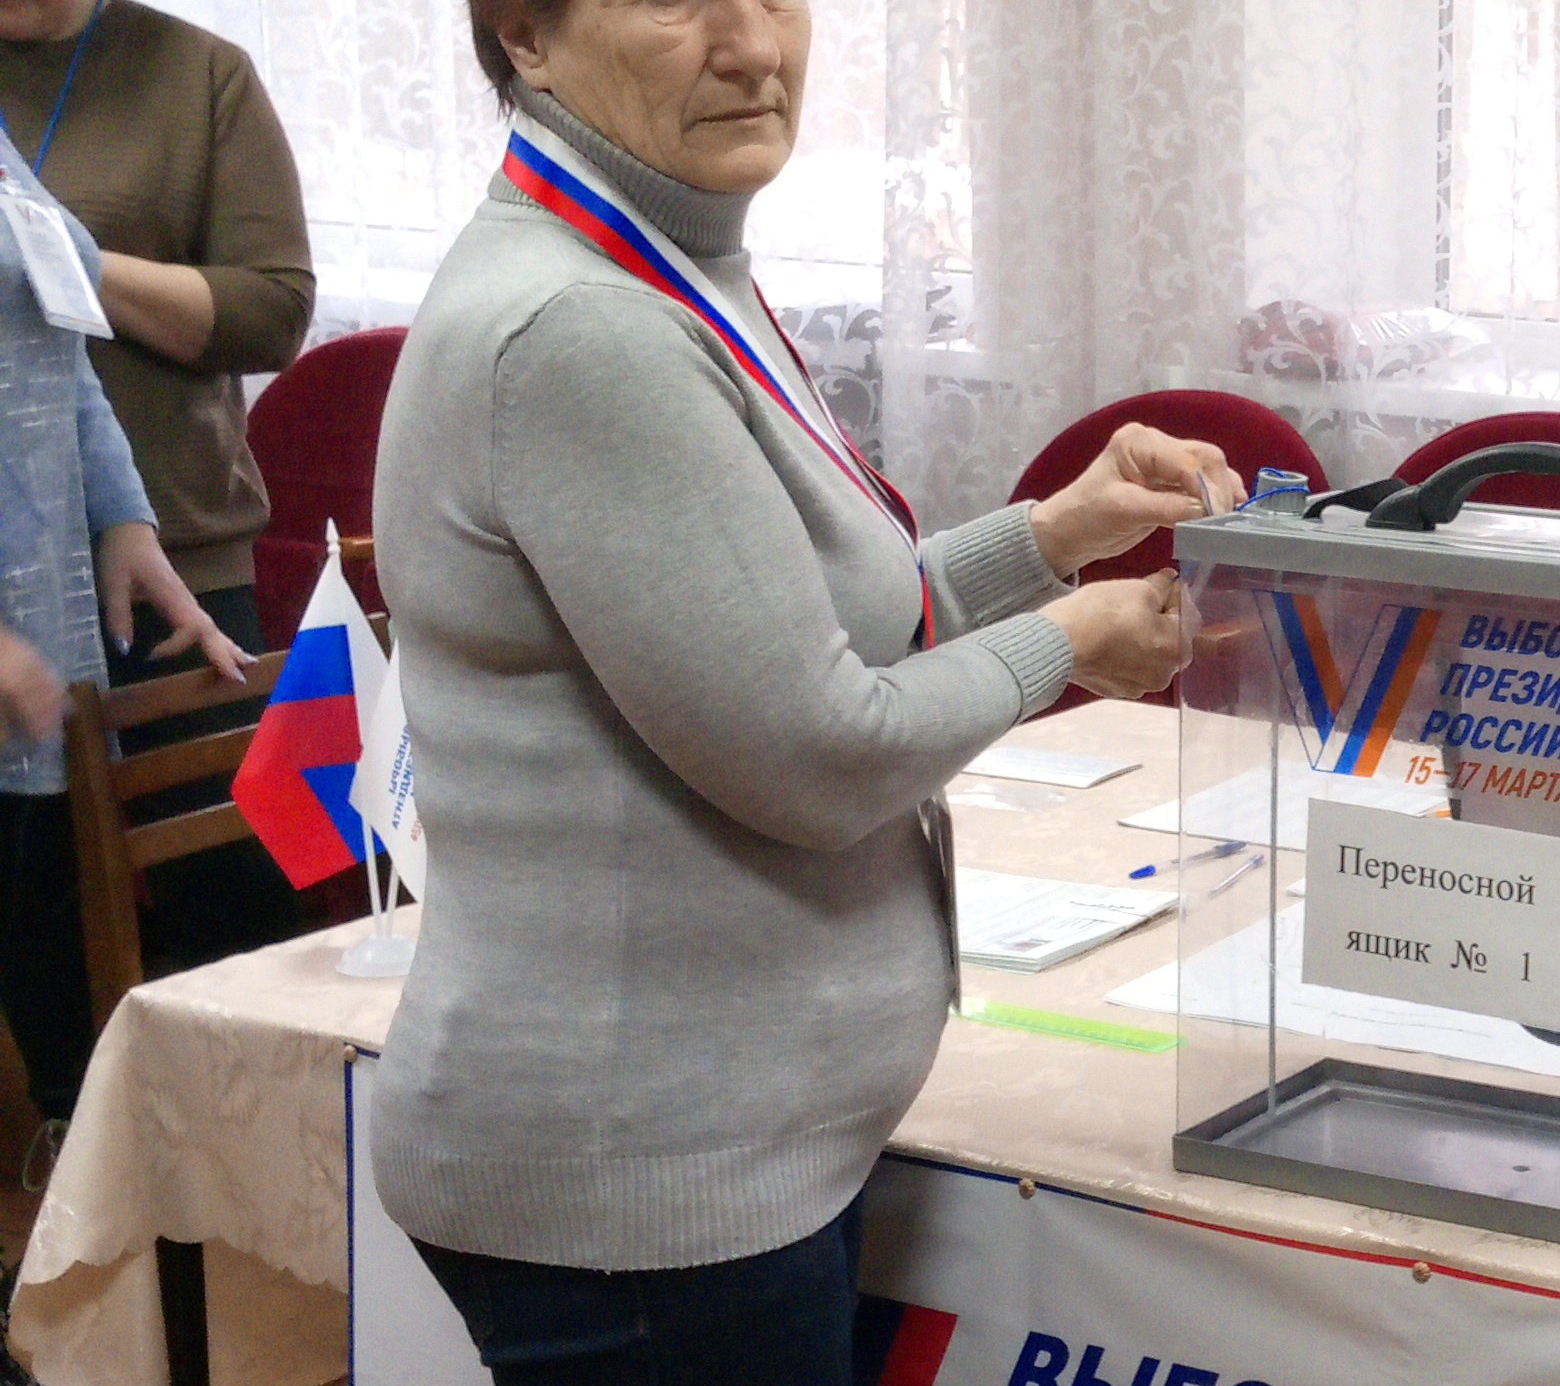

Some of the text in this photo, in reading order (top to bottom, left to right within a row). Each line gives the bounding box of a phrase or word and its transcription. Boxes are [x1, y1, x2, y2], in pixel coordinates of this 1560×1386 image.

[1337, 843, 1536, 906] Переносной
[1345, 930, 1532, 983] ящик № 1
